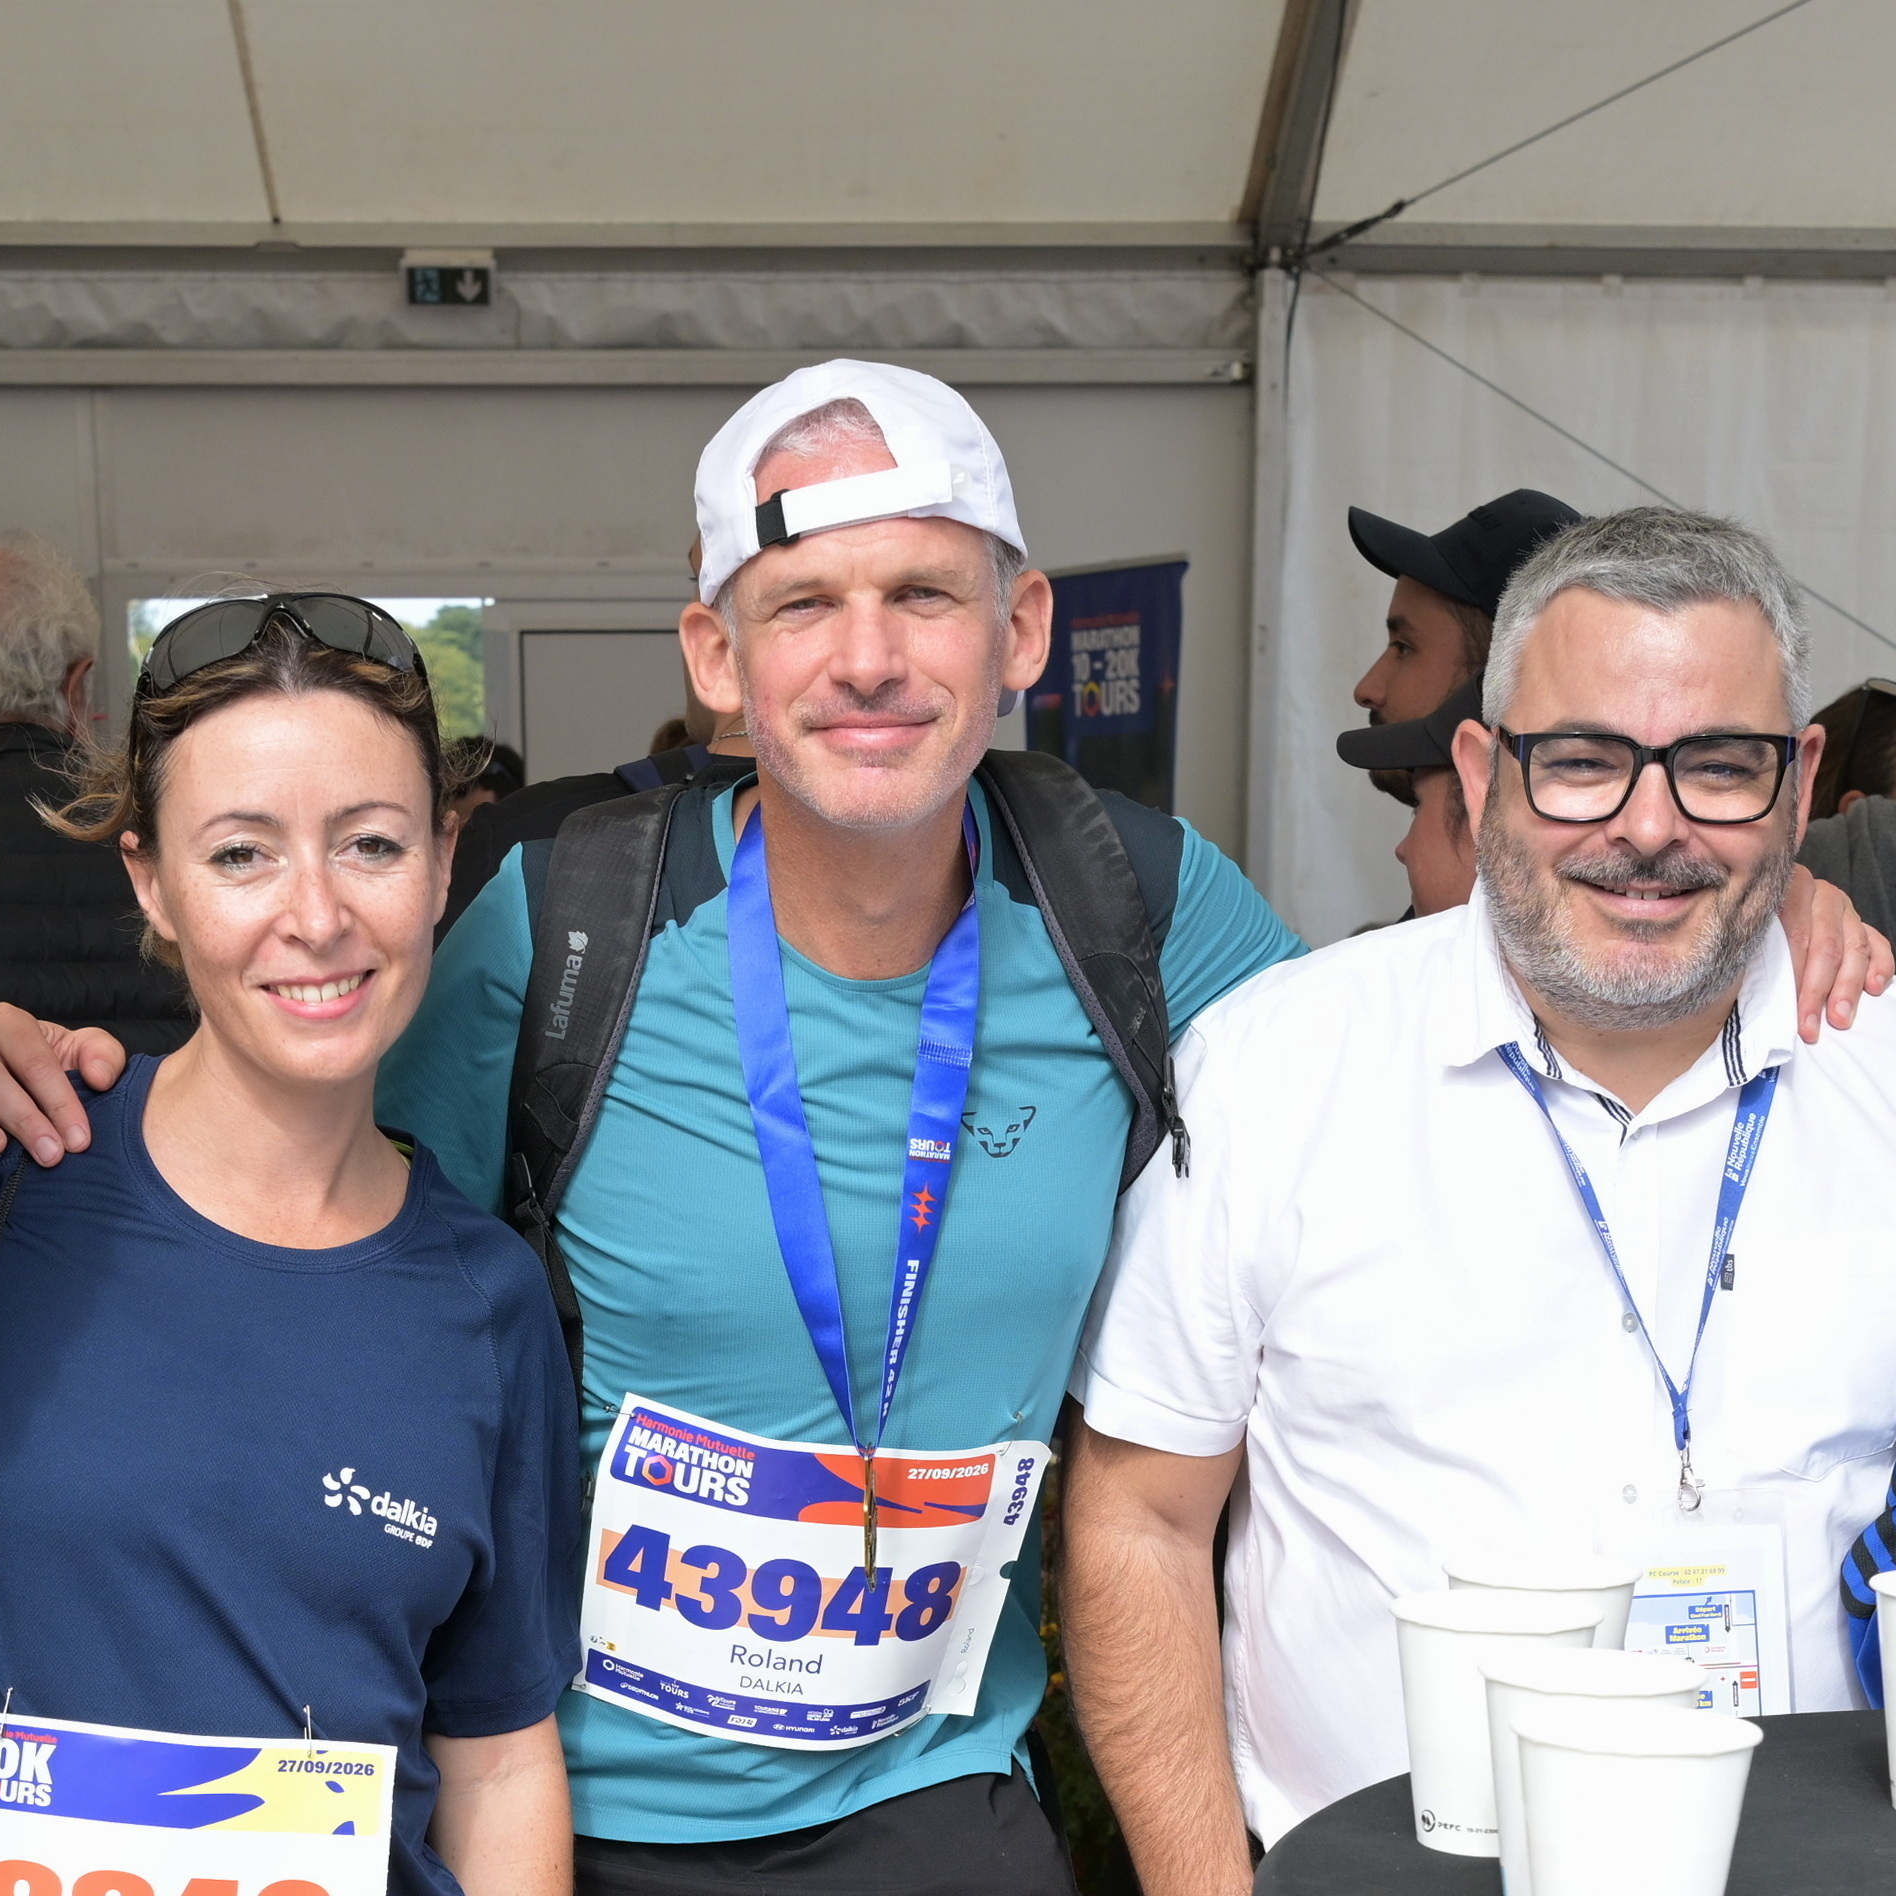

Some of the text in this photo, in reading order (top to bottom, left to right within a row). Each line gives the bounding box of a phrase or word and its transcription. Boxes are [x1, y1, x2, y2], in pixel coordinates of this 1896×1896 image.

[1105, 648, 1140, 679] 20K
[1071, 679, 1141, 718] TOURS
[545, 954, 583, 1040] Lafuma
[908, 1149, 951, 1160] MARATHON
[909, 1138, 951, 1151] TOURS
[1726, 1121, 1745, 1167] Nouvelle
[1734, 1112, 1756, 1172] République
[889, 1259, 920, 1365] FINISHER
[884, 1369, 895, 1399] 42
[628, 1425, 754, 1479] MARATHON
[635, 1413, 755, 1461] Harmonie Mutuelle
[624, 1445, 751, 1506] TOURS
[907, 1463, 989, 1480] 27/09/2026
[1003, 1457, 1035, 1526] 43948
[371, 1491, 438, 1536] dalkia
[384, 1523, 415, 1542] GROUPE
[603, 1524, 962, 1646] 43948
[961, 1628, 975, 1654] Roland
[1669, 1633, 1706, 1642] Marathon
[730, 1644, 823, 1675] Roland
[660, 1682, 689, 1699] TOURS
[739, 1675, 804, 1696] DALKIA
[785, 1725, 815, 1733] HYUNDAI
[277, 1760, 375, 1776] 27/09/2026
